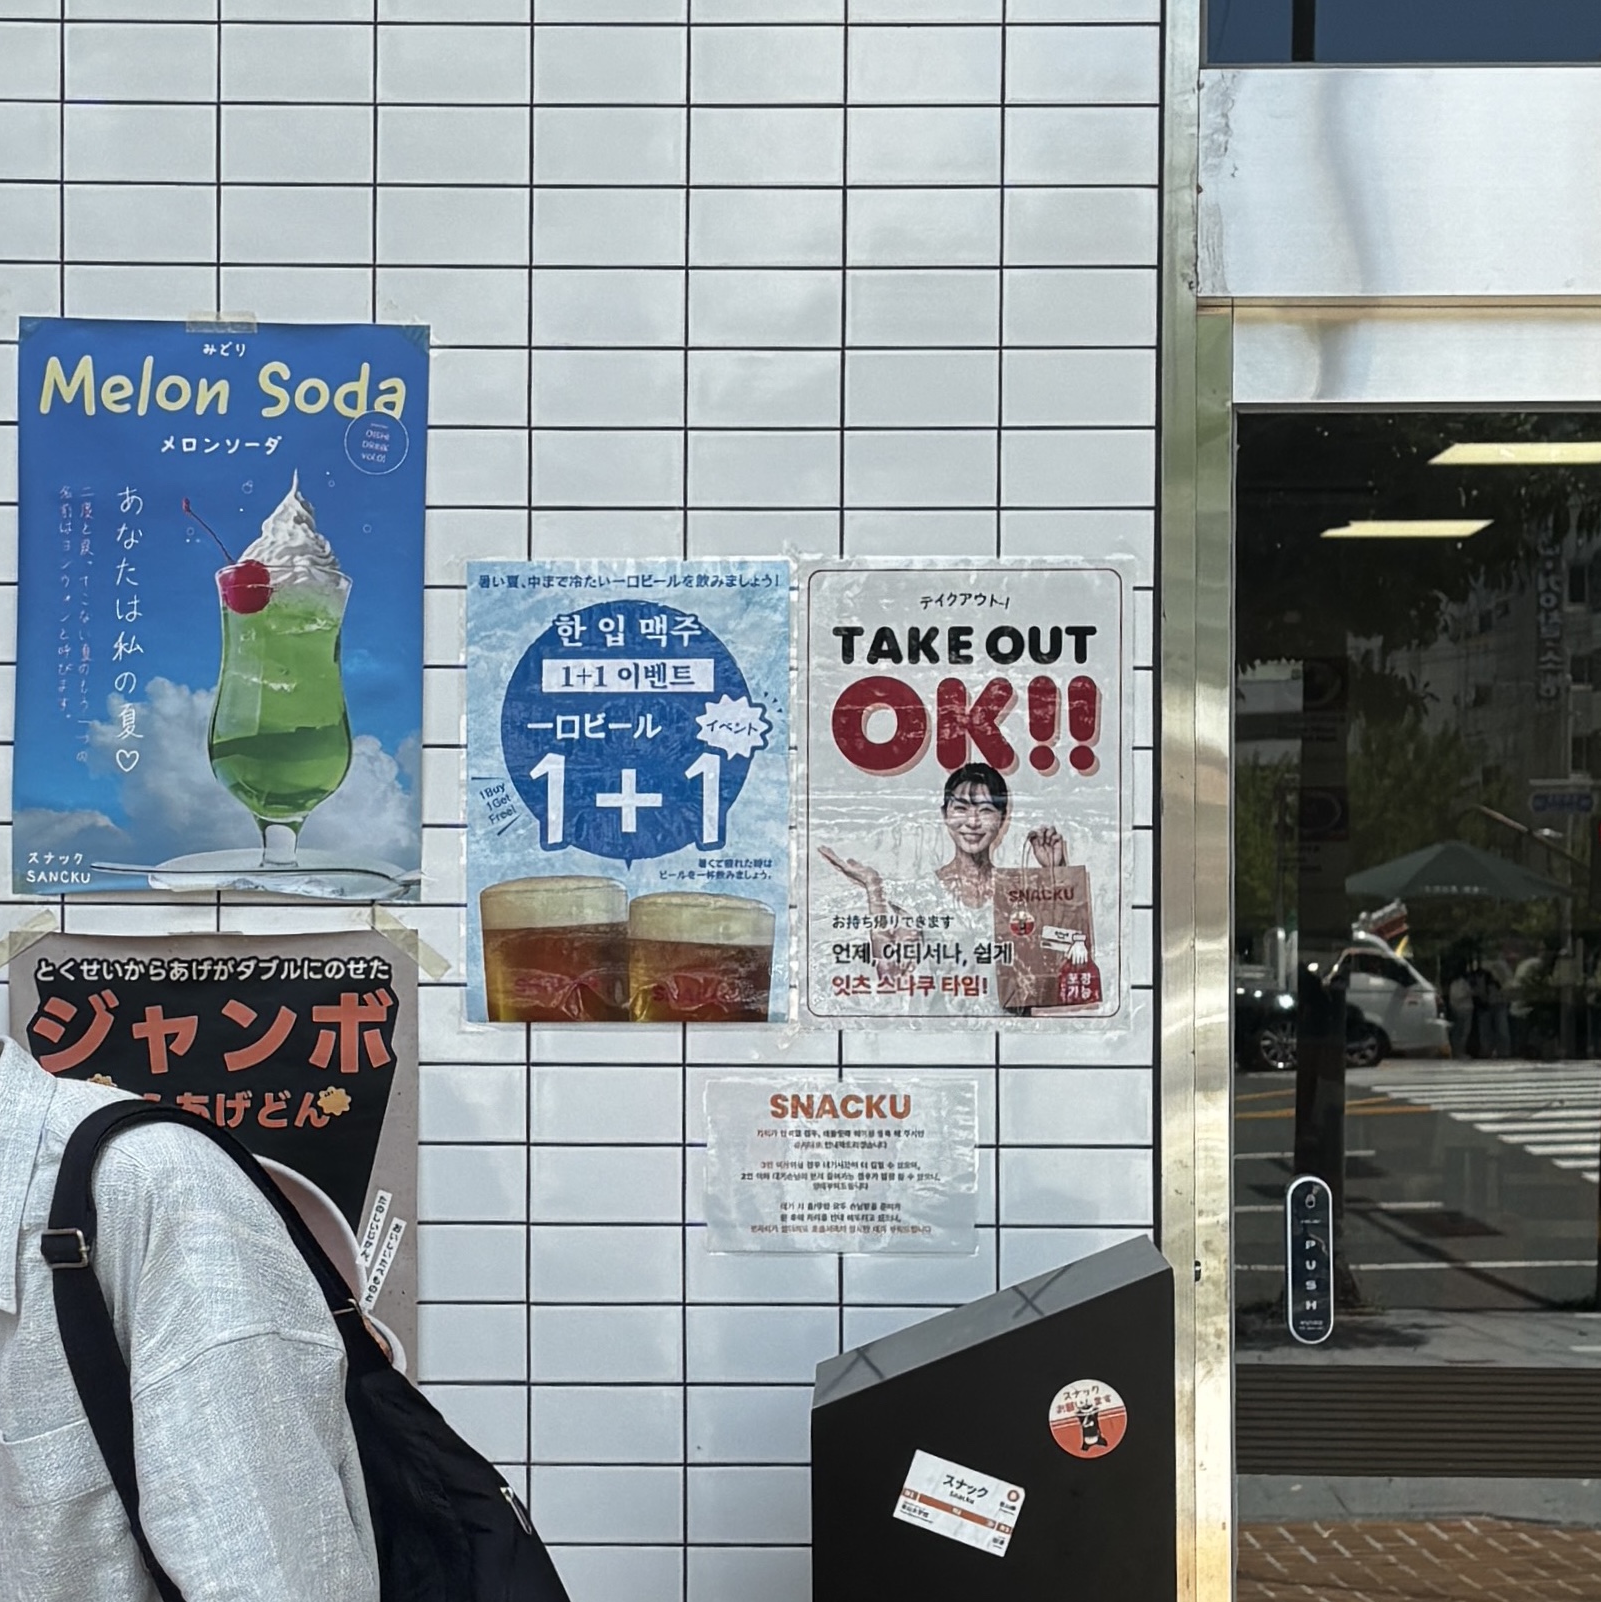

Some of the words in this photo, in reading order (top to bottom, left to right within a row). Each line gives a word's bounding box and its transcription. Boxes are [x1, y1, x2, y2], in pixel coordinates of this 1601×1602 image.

[202, 341, 248, 357] みどり
[39, 355, 230, 417] Melon
[257, 362, 407, 419] Soda
[160, 435, 282, 455] メロンソーダ
[555, 613, 587, 648] 한
[598, 614, 625, 647] 입
[639, 613, 703, 648] 맥주
[832, 626, 974, 665] TAKE
[985, 625, 1097, 665] OUT
[560, 665, 607, 688] 1+1
[617, 662, 696, 690] 이벤트
[527, 713, 662, 740] 一口ビール
[706, 719, 759, 736] イベント
[831, 675, 1103, 777] OK!!
[28, 851, 83, 865] スナック
[26, 869, 91, 884] SANCKU
[1008, 886, 1075, 902] SNACKU
[832, 914, 955, 929] お持ち帰りできます
[832, 942, 877, 967] 언제,
[882, 942, 968, 967] 어디서나,
[973, 942, 1014, 965] 쉽게
[36, 958, 391, 982] とくせいからあげがダブルにのせた
[831, 974, 874, 997] 잇츠
[876, 974, 936, 996] 스나쿠
[941, 974, 988, 996] 타임!
[32, 988, 394, 1074] ジャンボ
[770, 1093, 912, 1120] SNACKU
[1305, 1239, 1318, 1311] PUSH
[942, 1473, 989, 1499] スナック
